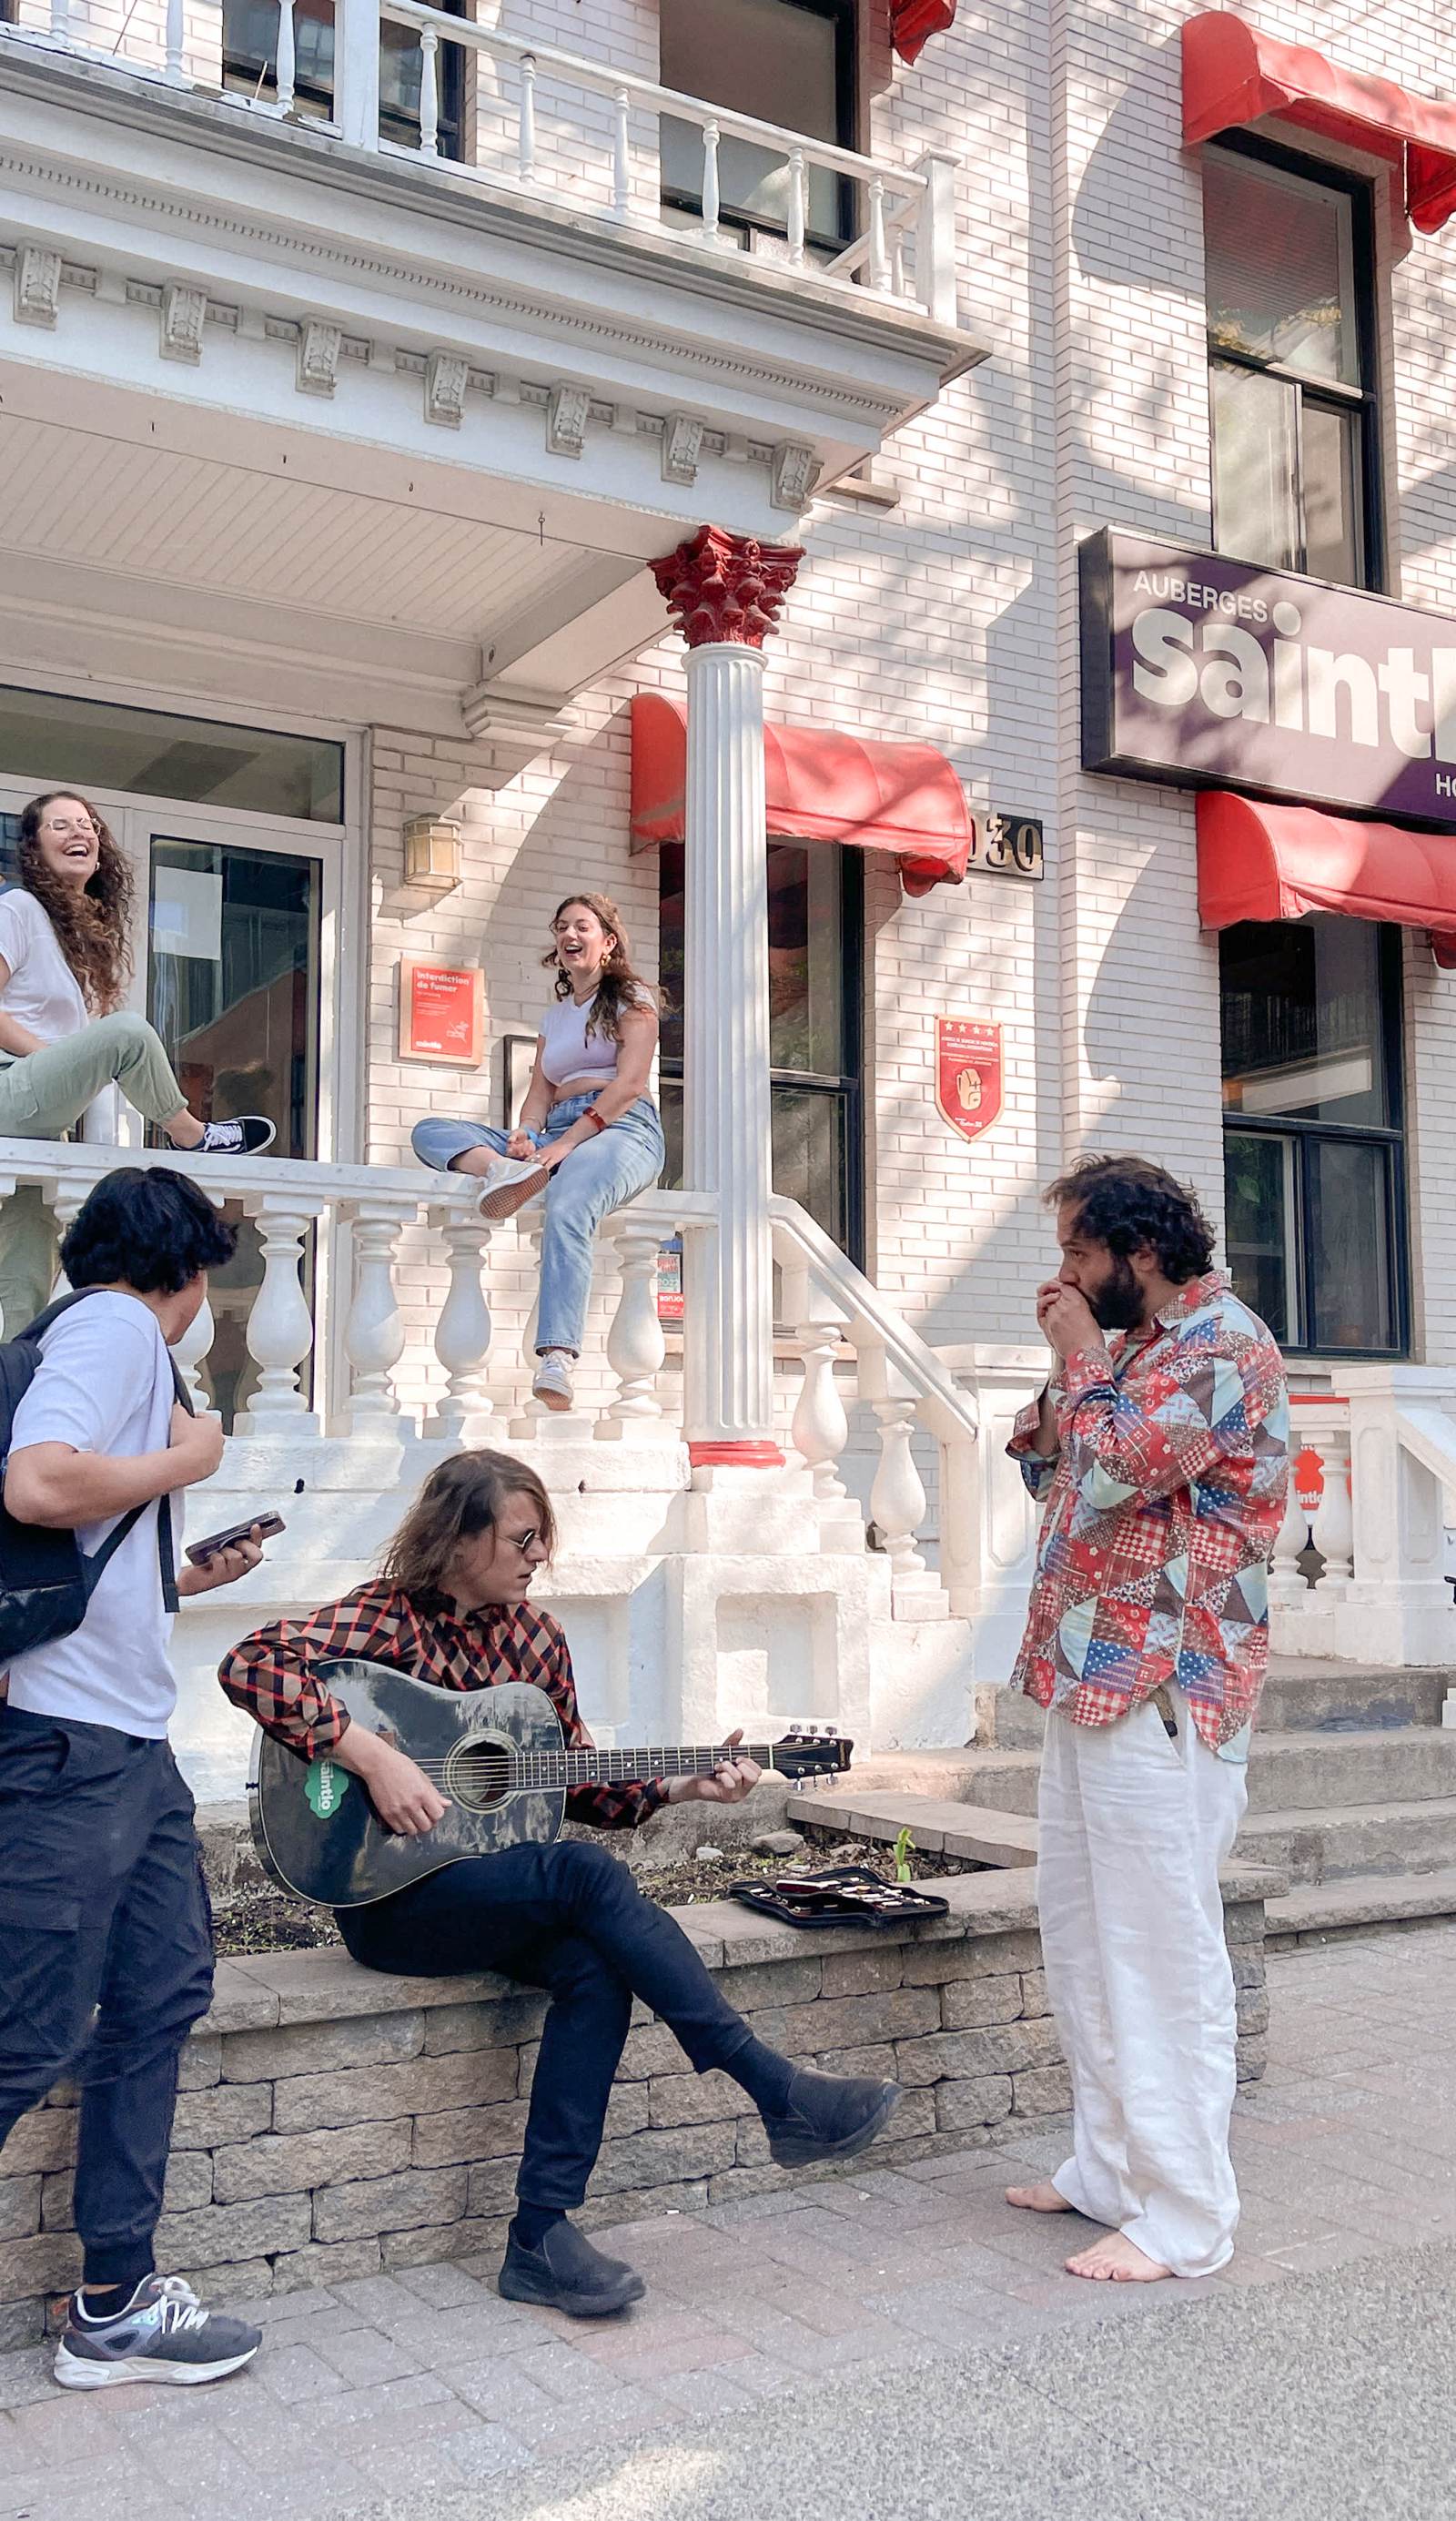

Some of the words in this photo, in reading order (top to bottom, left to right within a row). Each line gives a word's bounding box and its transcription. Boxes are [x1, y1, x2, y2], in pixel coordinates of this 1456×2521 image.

[1133, 571, 1268, 623] AUBERGES
[417, 980, 429, 989] de
[430, 982, 458, 992] fumer
